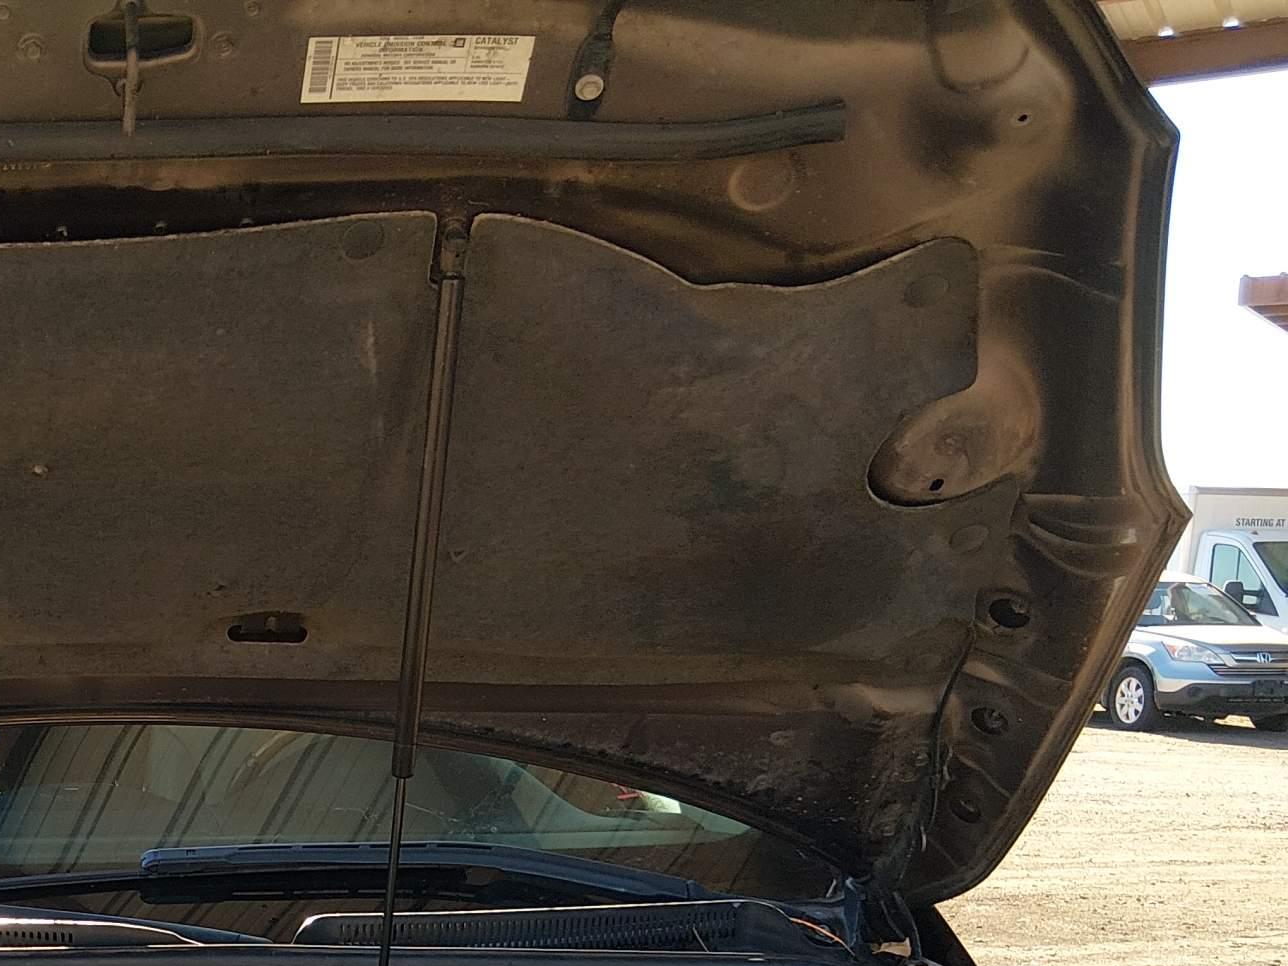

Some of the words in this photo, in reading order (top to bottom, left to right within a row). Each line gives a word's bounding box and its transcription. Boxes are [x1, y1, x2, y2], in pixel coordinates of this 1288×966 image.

[475, 36, 519, 46] CATALYST
[1235, 518, 1274, 527] STARTING
[1275, 518, 1287, 527] AT
